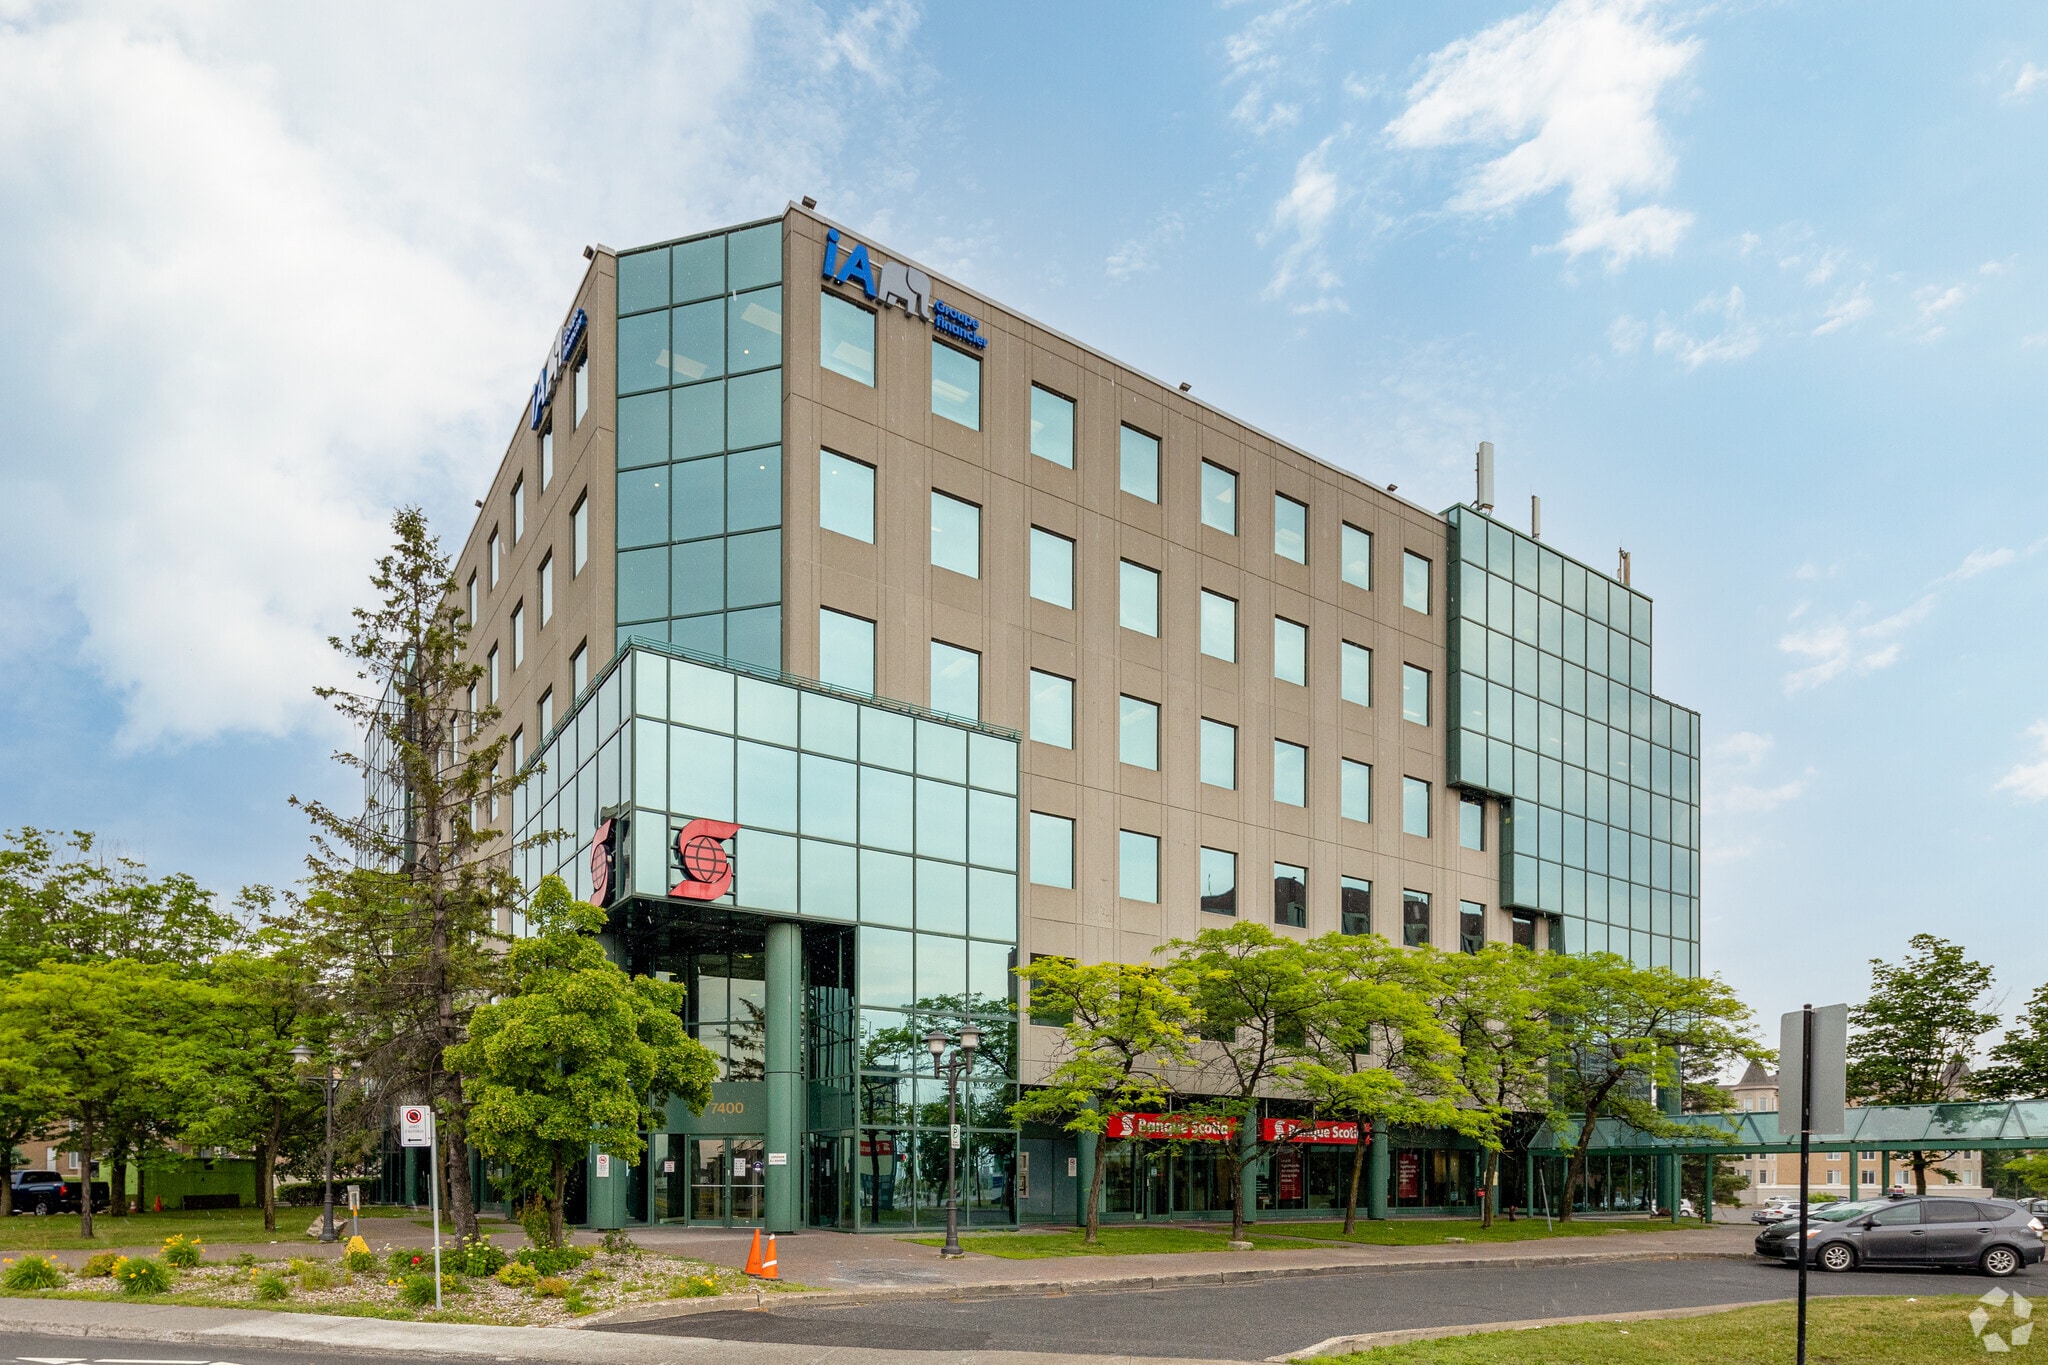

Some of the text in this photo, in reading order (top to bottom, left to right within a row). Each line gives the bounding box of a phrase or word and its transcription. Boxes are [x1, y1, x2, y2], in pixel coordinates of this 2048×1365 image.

[934, 299, 979, 330] Groupe
[935, 314, 988, 348] financier
[711, 1102, 744, 1115] 7400
[1332, 1126, 1359, 1139] Scoti
